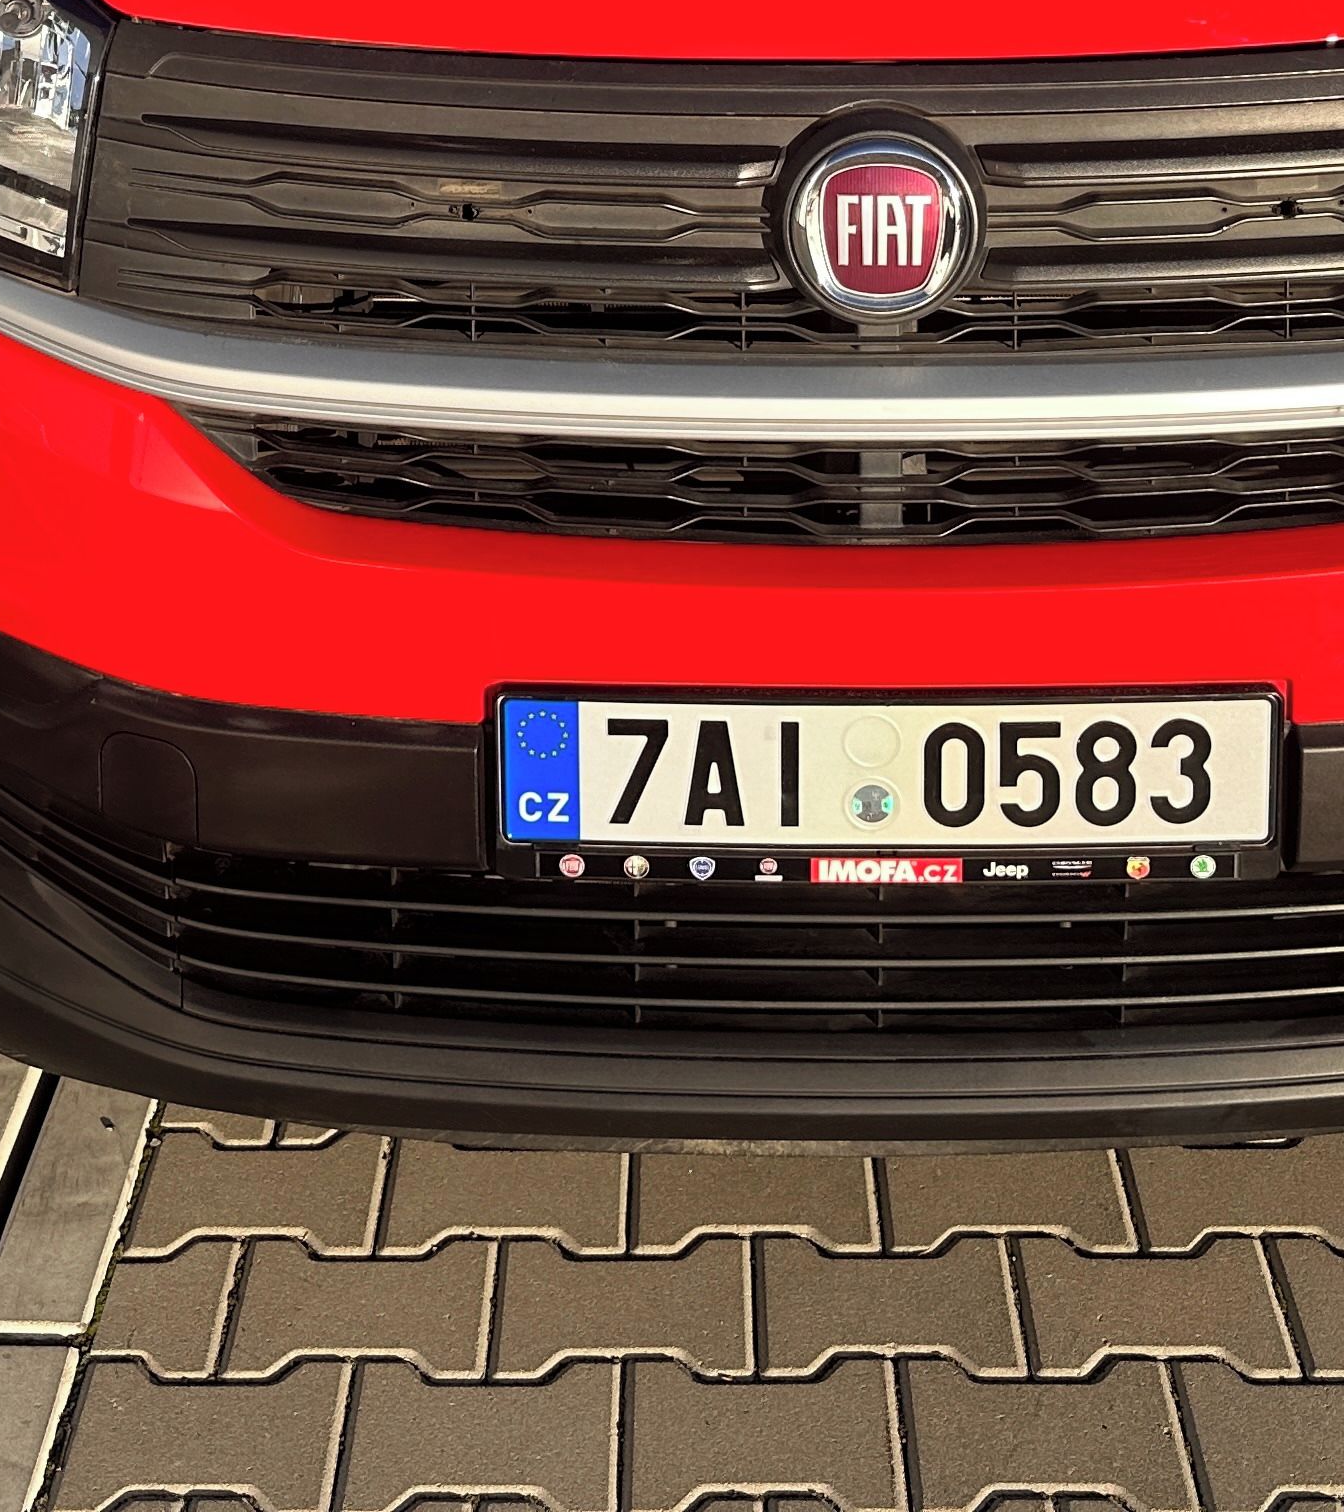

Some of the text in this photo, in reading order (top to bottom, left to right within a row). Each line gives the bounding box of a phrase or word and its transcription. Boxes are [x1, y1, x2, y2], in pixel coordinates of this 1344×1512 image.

[836, 194, 931, 266] FIAT
[607, 718, 1212, 828] 7AI 0583
[518, 791, 570, 823] CZ
[982, 861, 1029, 879] Jeep
